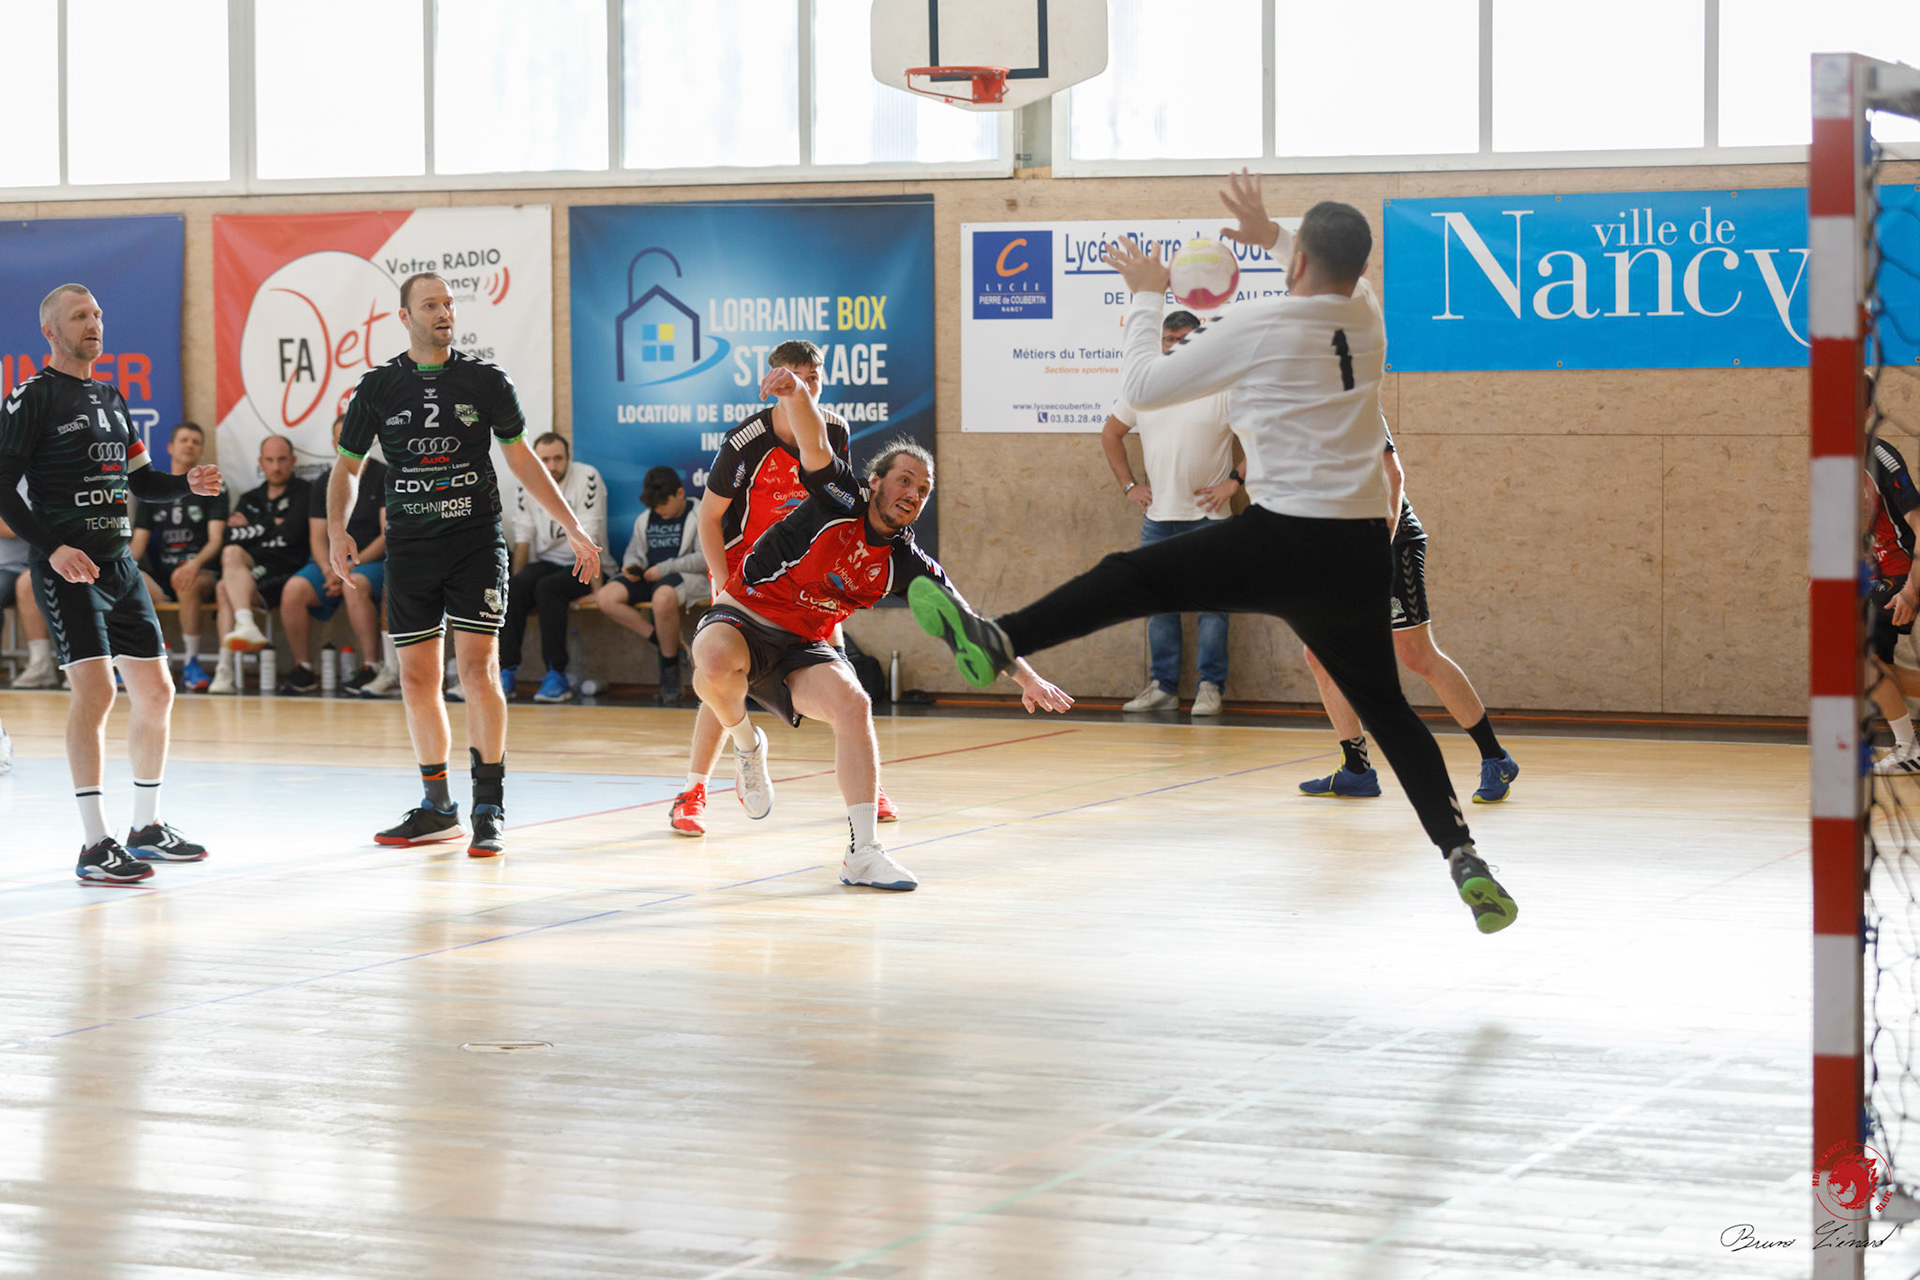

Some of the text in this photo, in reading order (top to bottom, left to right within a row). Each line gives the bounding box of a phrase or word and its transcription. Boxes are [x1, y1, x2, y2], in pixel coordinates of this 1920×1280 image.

[1592, 206, 1736, 247] ville de
[386, 248, 501, 275] Votre RADIO
[448, 276, 480, 293] ncy
[1430, 209, 1811, 348] Nancy
[979, 296, 1001, 305] PIERRE
[1011, 295, 1047, 305] COUBERTIN
[1104, 292, 1125, 305] DE
[709, 296, 888, 332] LORRAINE BOX
[1012, 347, 1057, 360] Métiers
[1059, 348, 1075, 360] du
[1331, 328, 1355, 392] 1
[733, 343, 889, 387] STKAGE
[1043, 365, 1119, 376] Sections sportives
[423, 403, 440, 429] 2
[617, 404, 692, 424] LOCATION
[697, 404, 719, 424] DE
[1012, 402, 1102, 412] www.lyceecoubertin.fr
[97, 408, 112, 432] 4
[101, 463, 122, 472] Audi
[420, 456, 450, 465] Audi
[402, 466, 447, 474] Quattromotors
[402, 497, 472, 515] TECHNIPOSE
[441, 509, 472, 520] NANCY
[171, 507, 182, 526] 6
